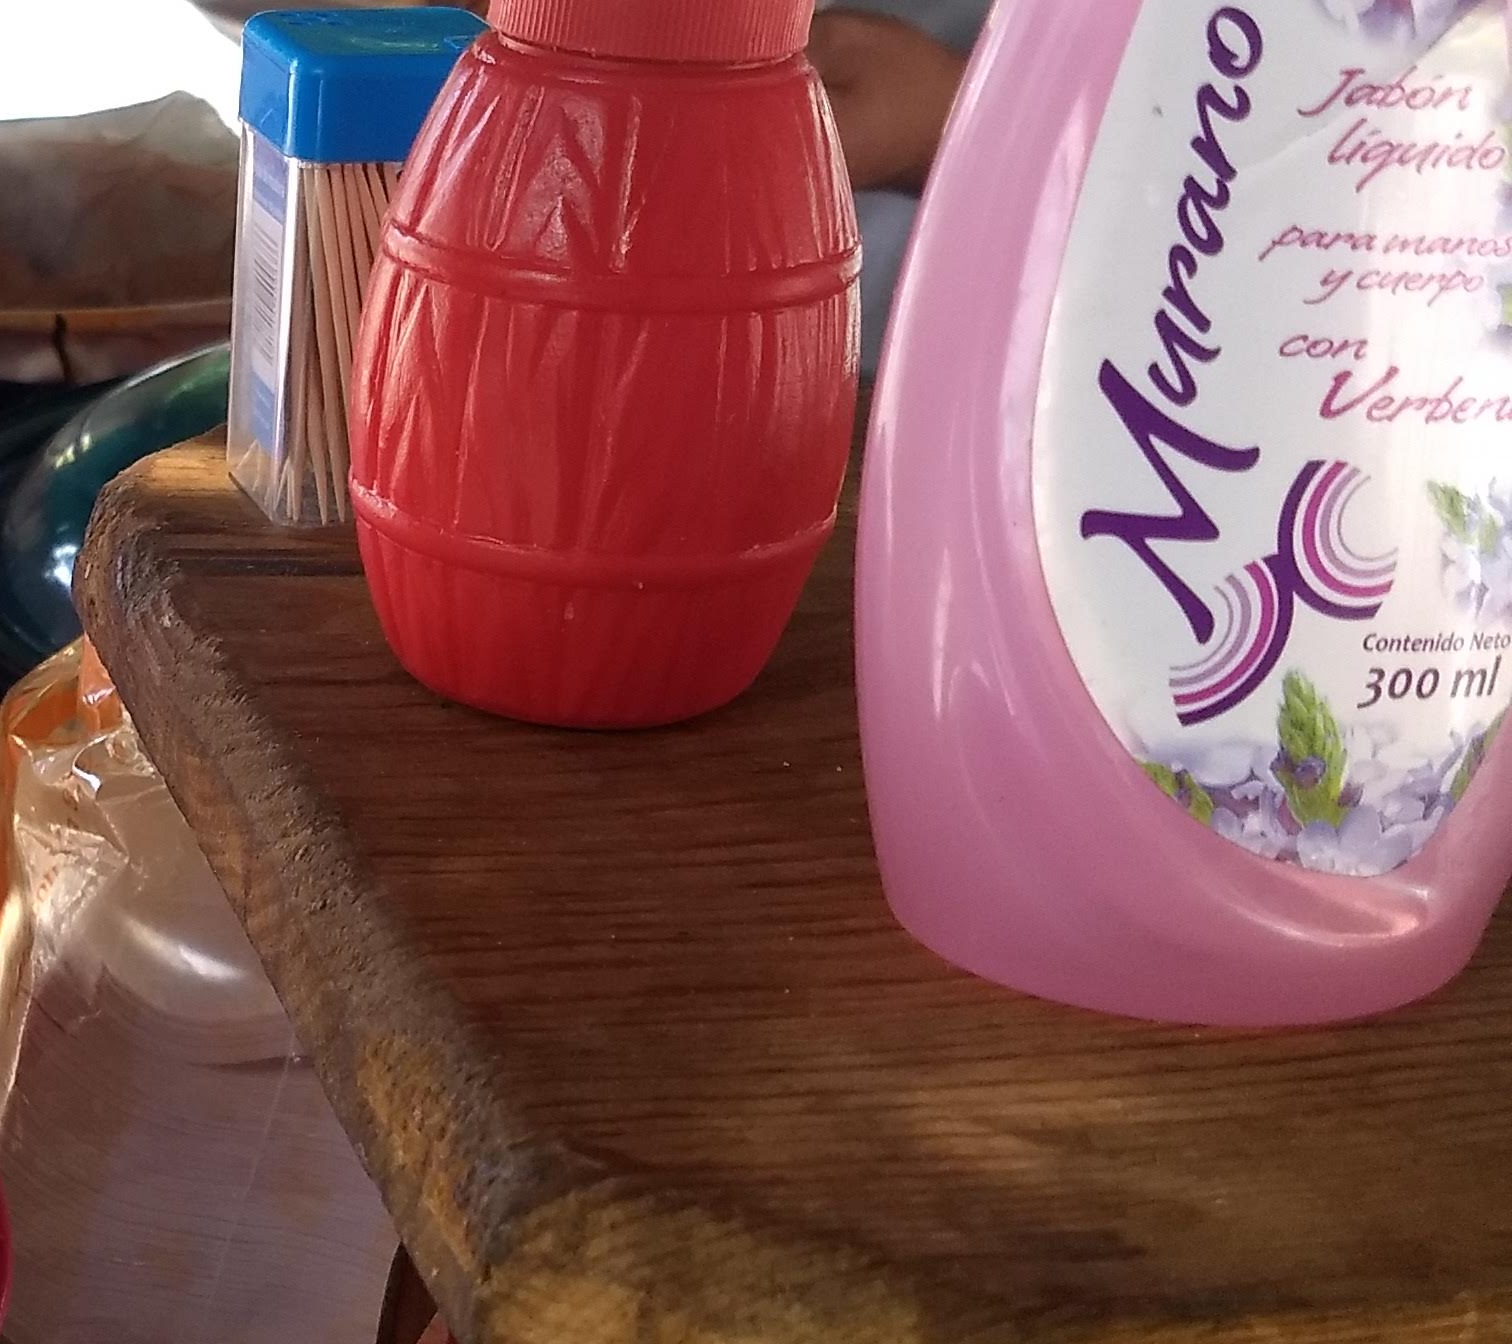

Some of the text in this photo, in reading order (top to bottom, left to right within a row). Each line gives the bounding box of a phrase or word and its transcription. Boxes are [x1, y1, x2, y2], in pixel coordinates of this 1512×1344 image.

[1296, 65, 1473, 117] Jabón
[1257, 224, 1512, 262] para manos
[1302, 269, 1485, 308] y cuerpo
[1080, 5, 1264, 645] Murano
[1278, 333, 1368, 360] con
[1319, 365, 1512, 425] Verben
[1362, 631, 1511, 653] Contenido Neto
[1356, 654, 1503, 710] 300 ml
